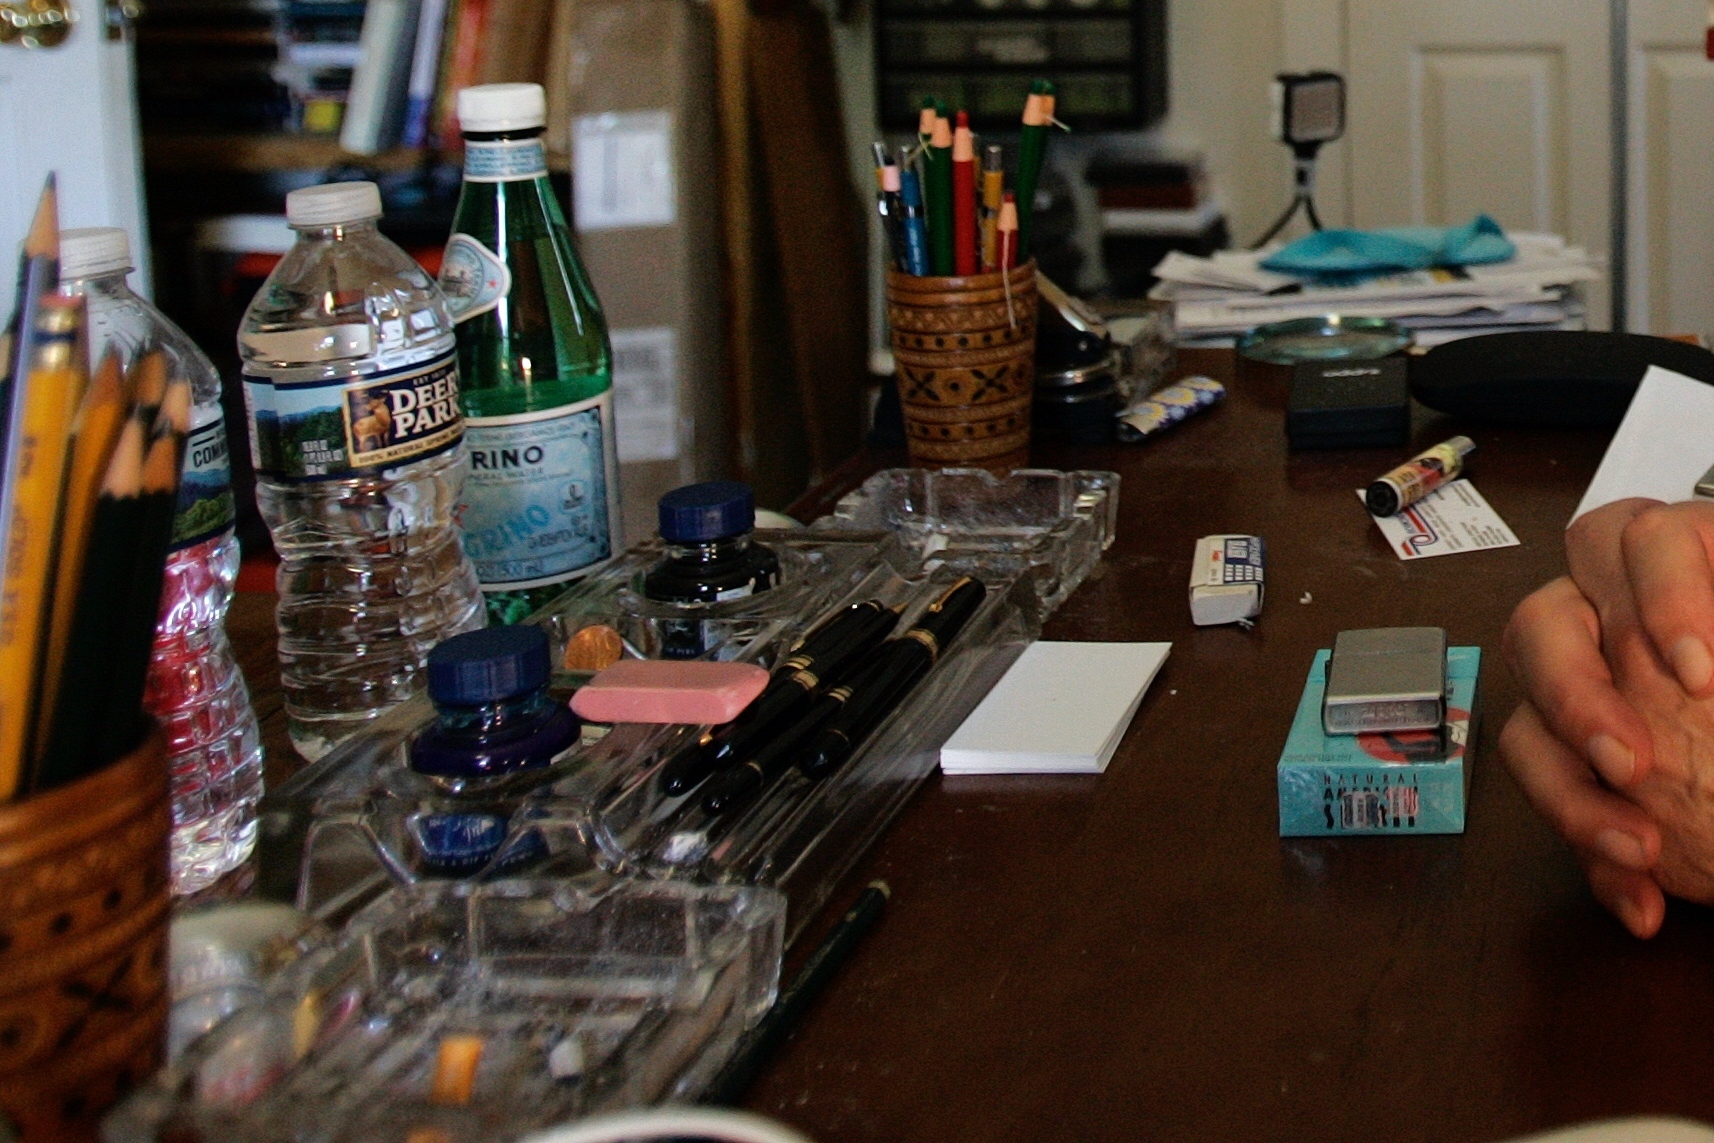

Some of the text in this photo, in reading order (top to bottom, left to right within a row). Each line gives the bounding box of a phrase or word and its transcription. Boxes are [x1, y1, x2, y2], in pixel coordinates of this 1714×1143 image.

[389, 371, 459, 415] DEER
[392, 396, 463, 438] PARK
[471, 445, 544, 470] RINO
[1324, 773, 1418, 785] NATURAL
